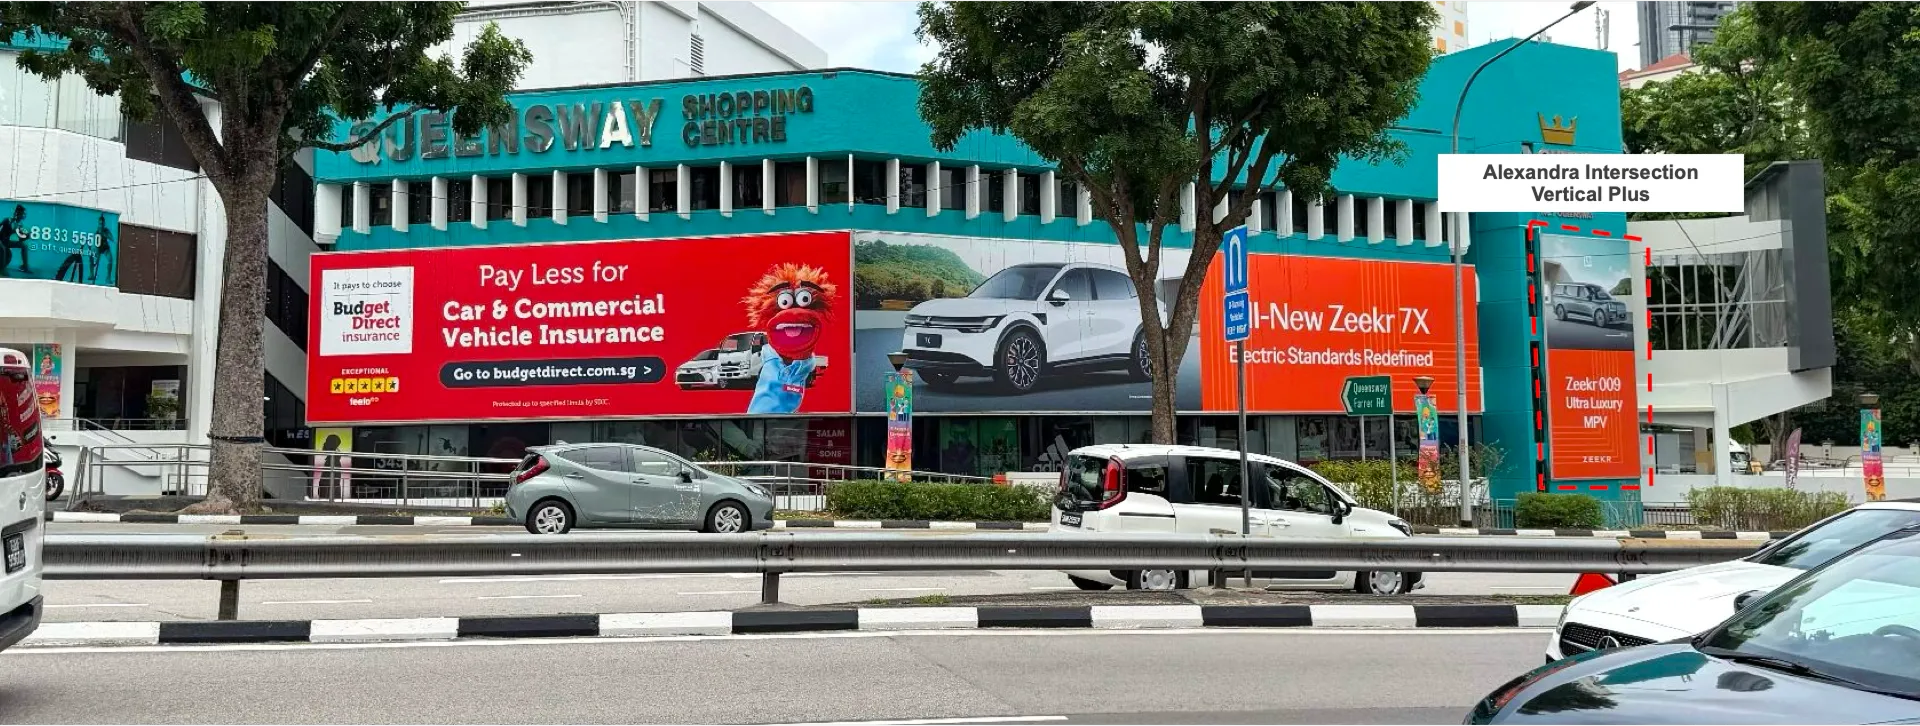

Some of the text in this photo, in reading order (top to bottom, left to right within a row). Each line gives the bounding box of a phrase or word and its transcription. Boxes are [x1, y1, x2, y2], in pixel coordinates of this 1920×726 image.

[682, 86, 814, 120] SHOPPING
[682, 115, 787, 148] CENTRE
[72, 230, 102, 248] 5550
[479, 260, 629, 292] Pay Less for
[333, 280, 402, 291] It pays to choose
[333, 300, 390, 318] Budget
[443, 294, 665, 321] Car & Commercial
[351, 316, 401, 330] Direct
[1249, 302, 1430, 334] ll-New Zeekr 7X
[342, 331, 400, 343] insurance
[442, 324, 665, 347] Vehicle Insurance
[1229, 344, 1433, 367] Eectric Standards Redefined
[453, 364, 636, 382] Go to budgetdirect.com.sg
[1353, 383, 1388, 395] Queensway
[1565, 376, 1621, 391] Zeekr 009
[585, 398, 594, 406] by
[1353, 397, 1385, 408] Farrer Rd
[1566, 396, 1623, 412] Ultra Luxury
[1583, 415, 1607, 428] MPV
[816, 429, 845, 438] SALAM
[818, 450, 842, 458] SONS
